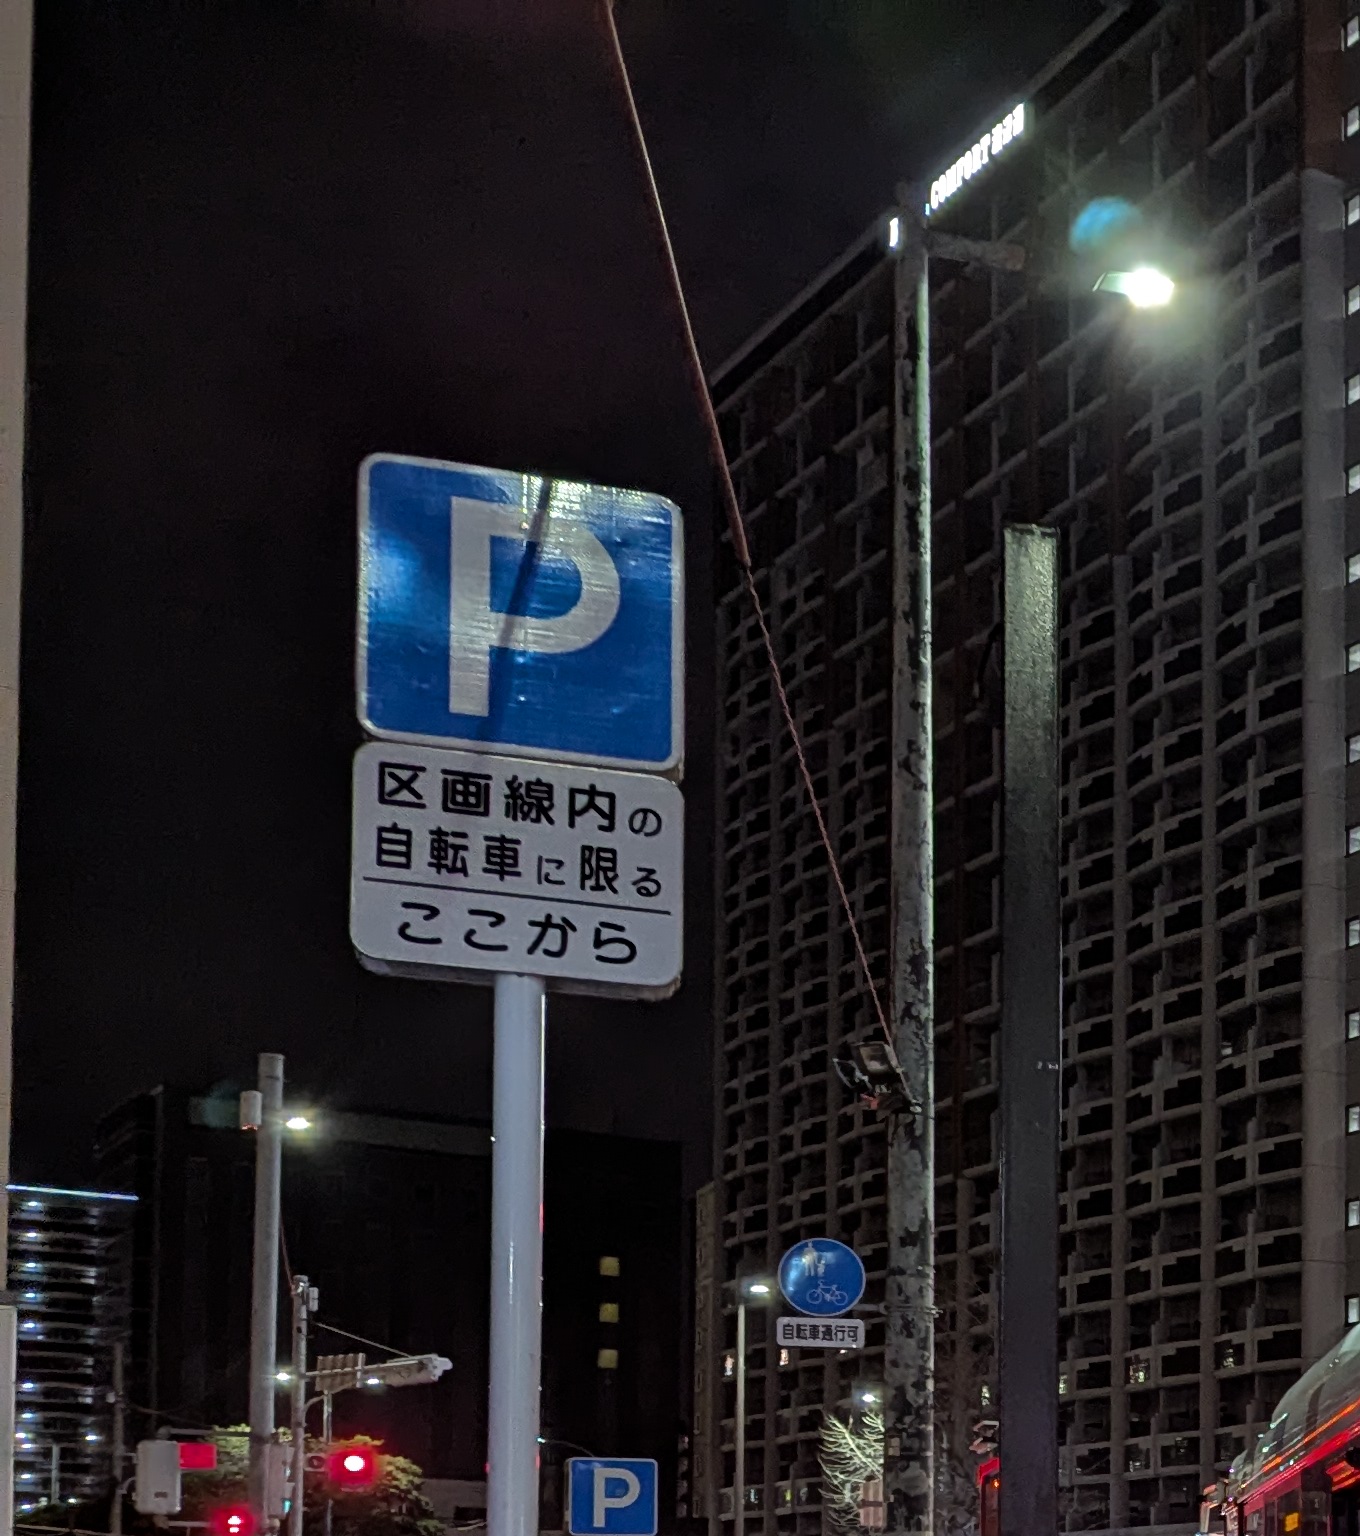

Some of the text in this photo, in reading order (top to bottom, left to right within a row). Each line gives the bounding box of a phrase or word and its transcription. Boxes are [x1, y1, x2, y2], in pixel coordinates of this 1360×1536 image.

[448, 496, 620, 717] P
[377, 760, 662, 838] 区画線内の
[375, 822, 662, 898] 自転車に限る
[397, 902, 638, 965] ここから
[782, 1322, 860, 1343] 自転車通行可
[593, 1467, 641, 1528] P
